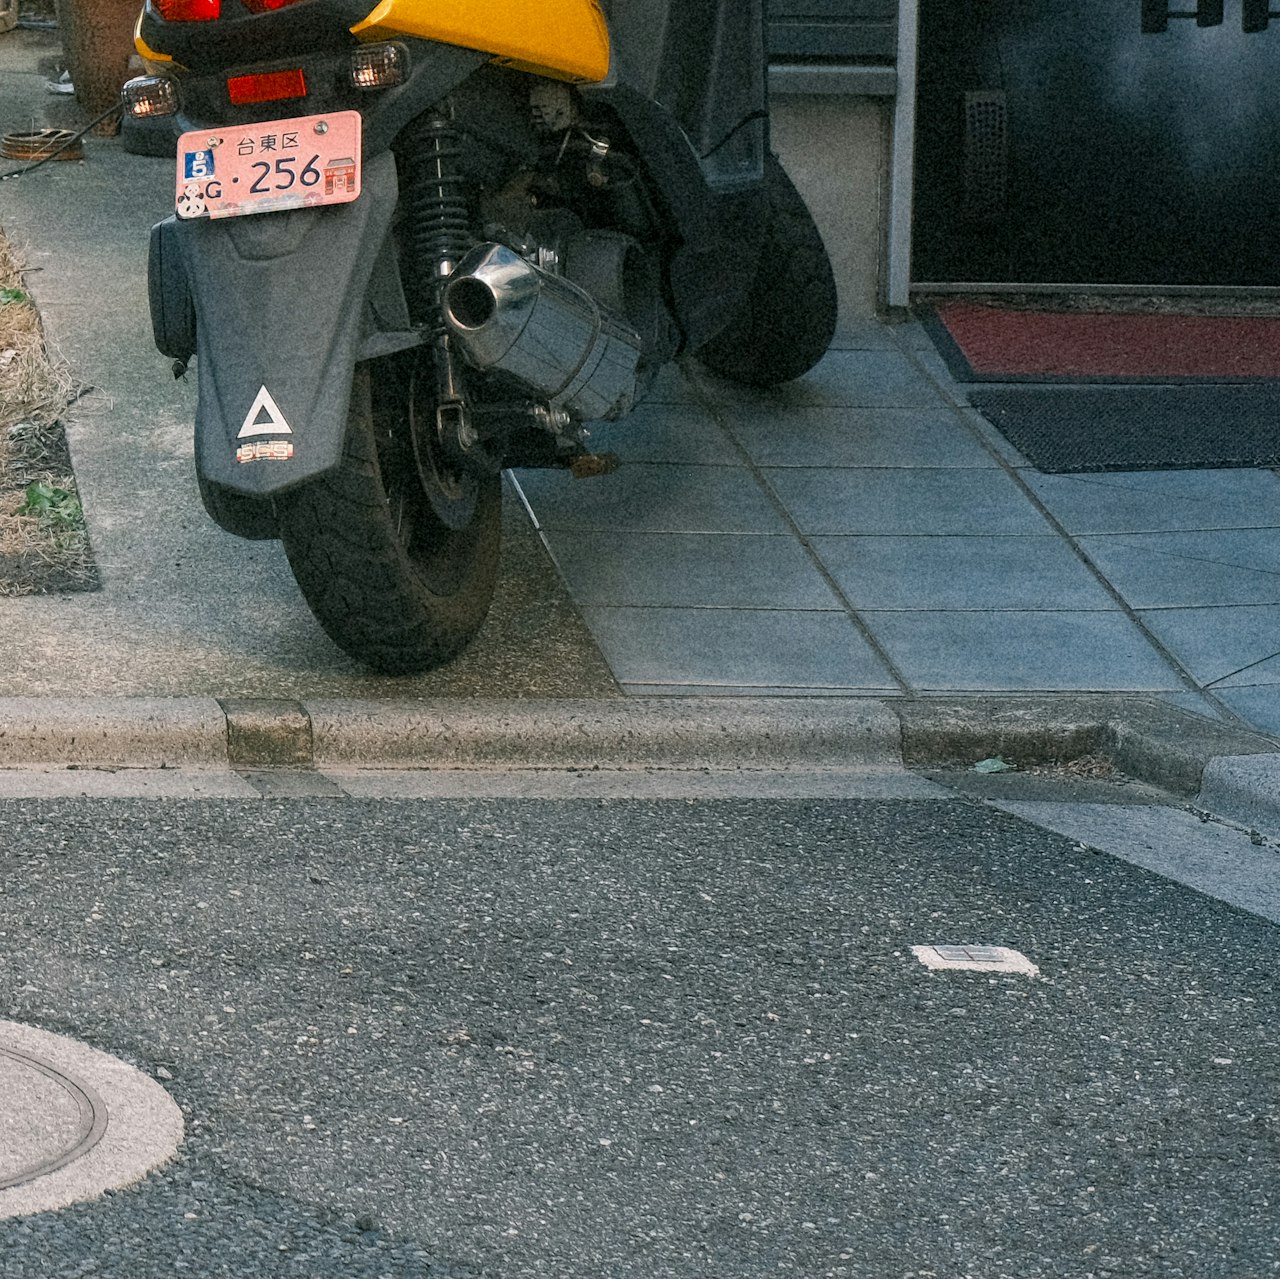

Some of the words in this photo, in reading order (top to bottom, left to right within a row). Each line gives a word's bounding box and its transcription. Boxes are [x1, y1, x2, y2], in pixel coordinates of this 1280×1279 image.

[237, 132, 299, 156] 台東区
[205, 181, 222, 199] G
